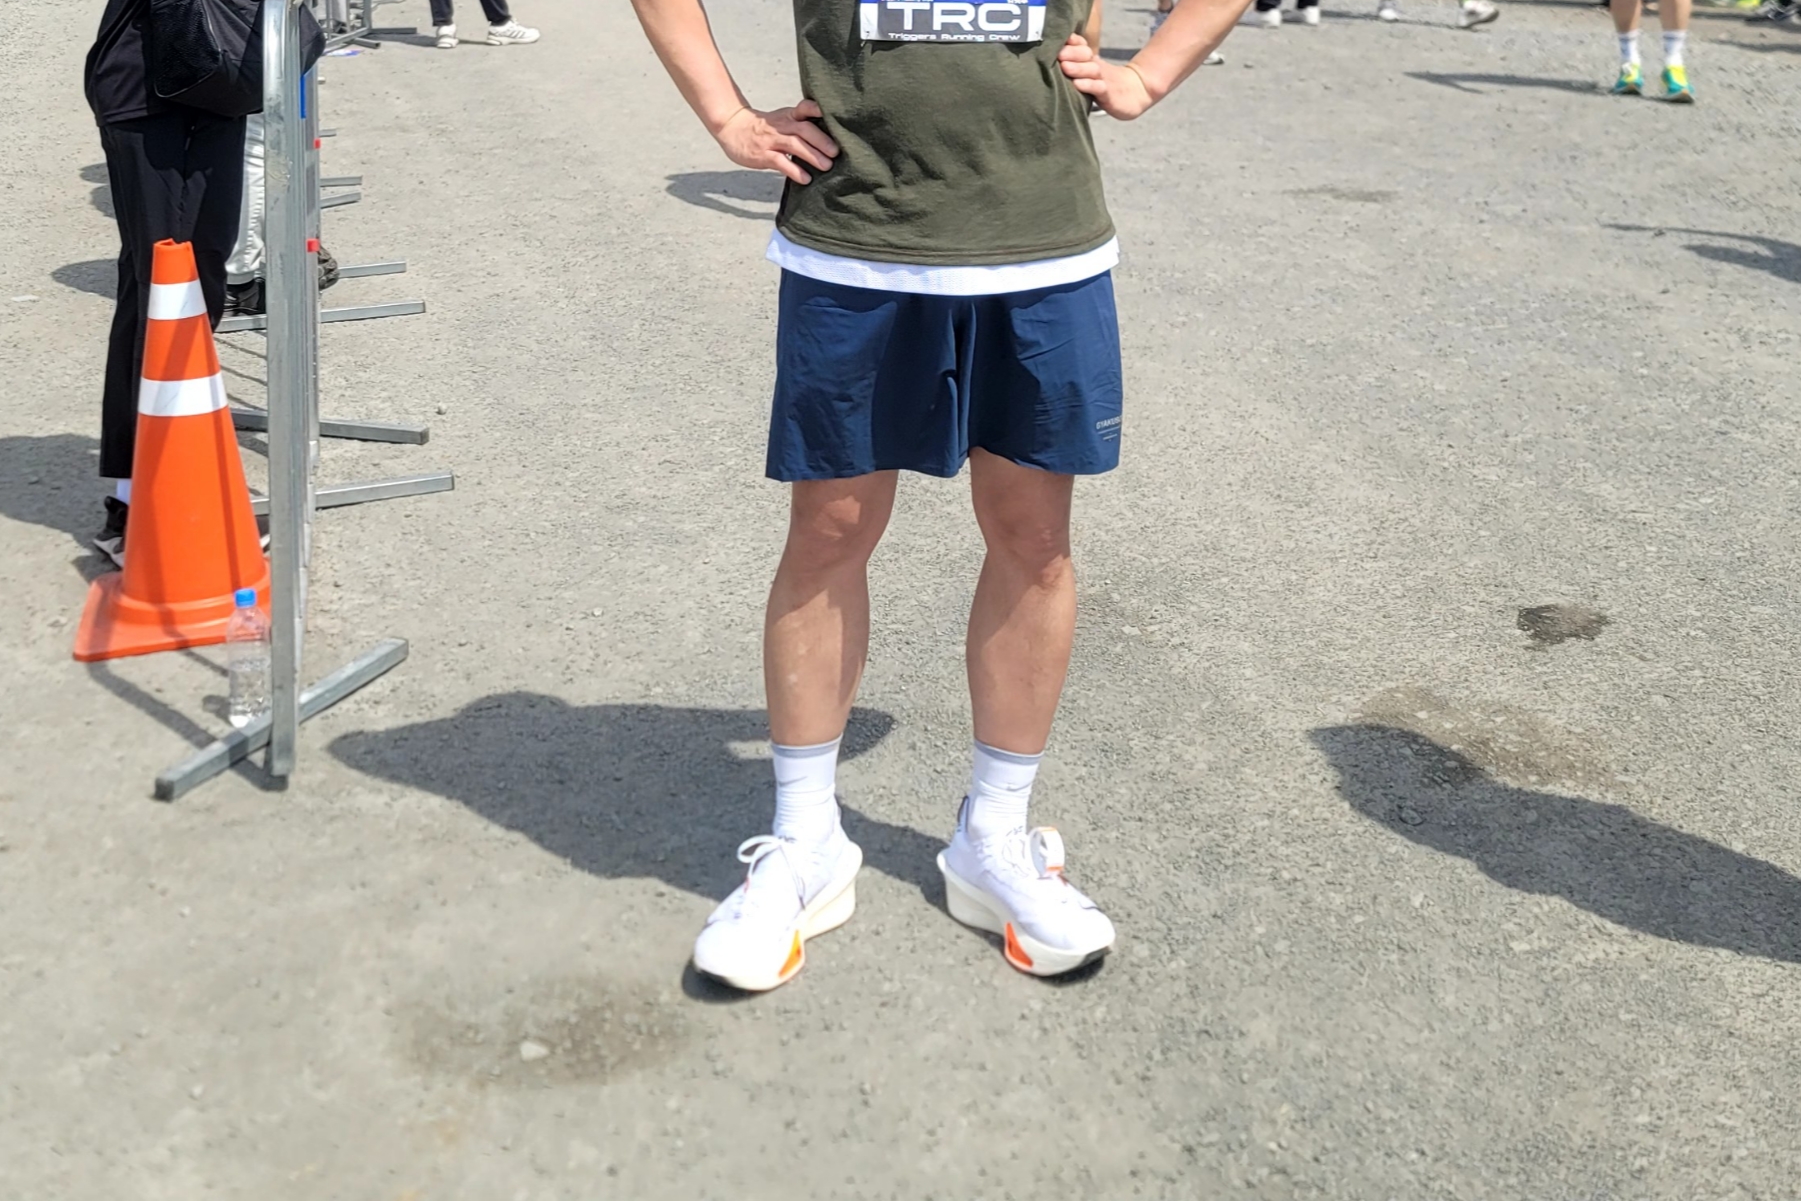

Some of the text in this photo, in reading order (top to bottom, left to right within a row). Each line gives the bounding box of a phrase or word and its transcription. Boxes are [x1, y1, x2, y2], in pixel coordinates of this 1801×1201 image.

[886, 2, 1022, 31] TRC
[888, 33, 937, 41] Triggers
[941, 33, 985, 41] Running
